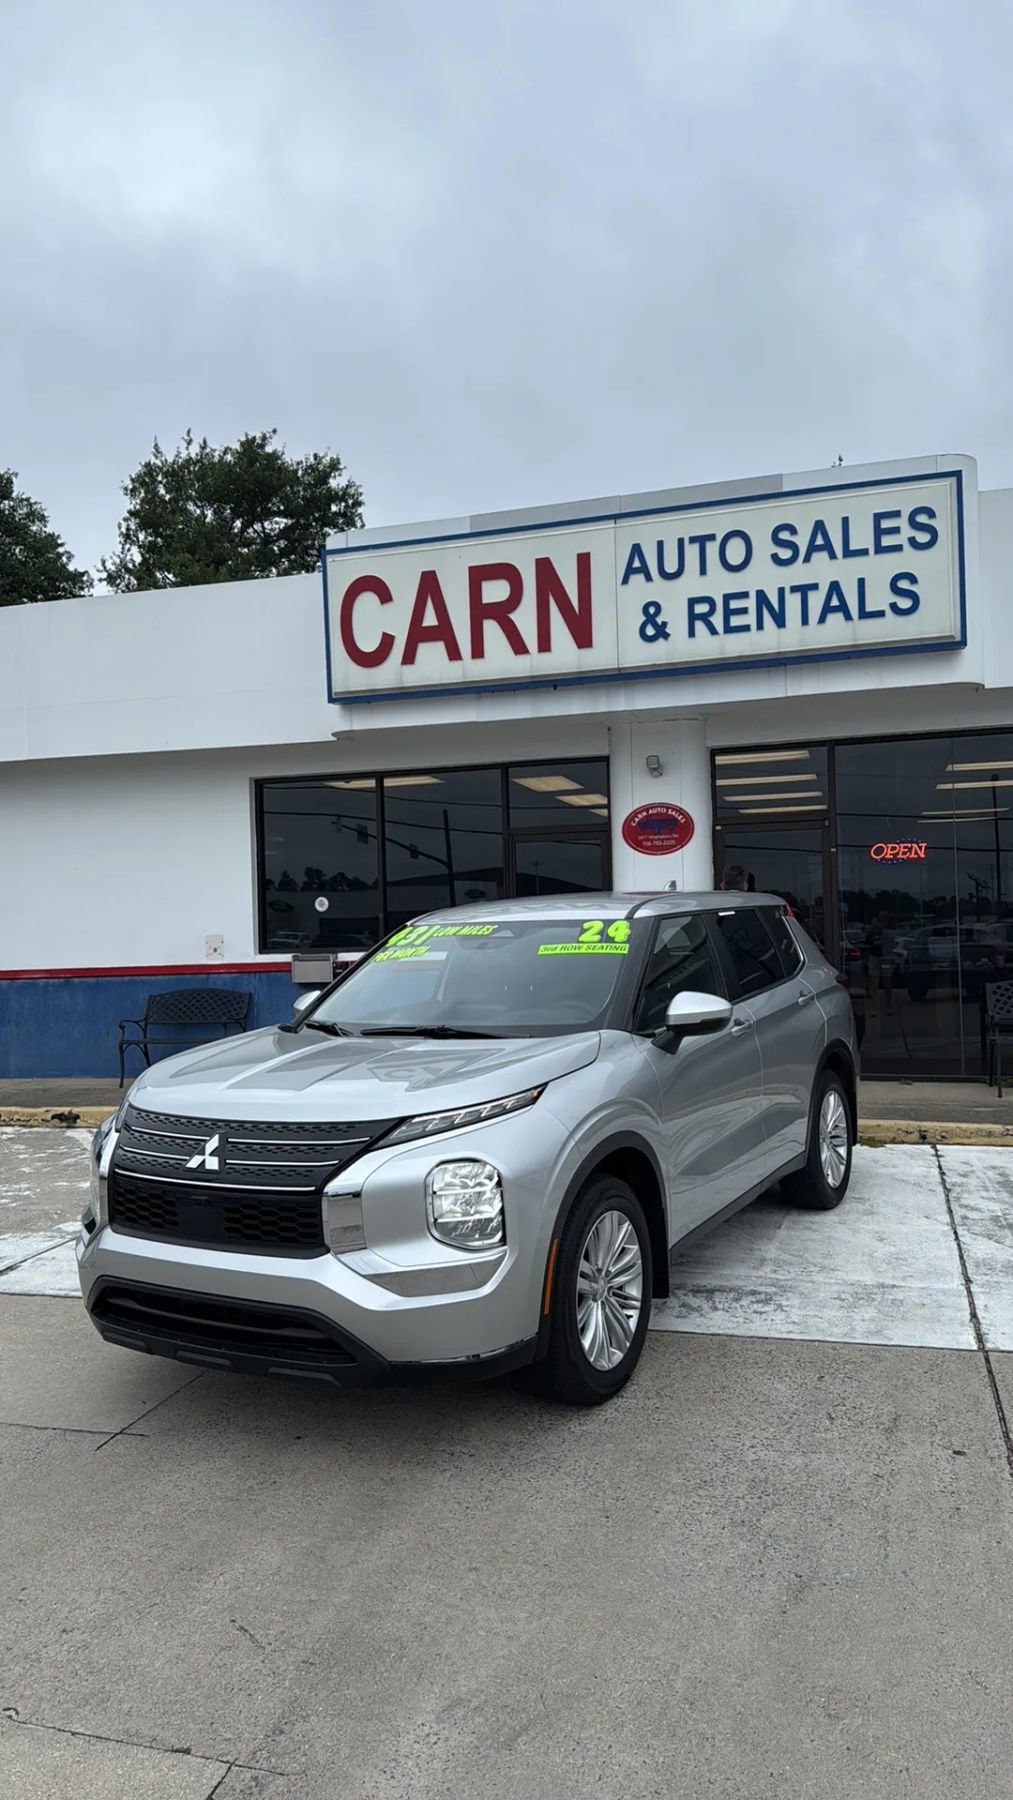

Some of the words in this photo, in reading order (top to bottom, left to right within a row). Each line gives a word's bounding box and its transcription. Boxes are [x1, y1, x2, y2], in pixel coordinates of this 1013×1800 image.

[621, 529, 753, 585] AUTO
[770, 505, 939, 567] SALES
[341, 553, 594, 669] CARN
[639, 601, 670, 643] &
[686, 570, 921, 638] RENTALS
[870, 842, 928, 860] OPEN
[432, 926, 463, 937] LOW
[456, 925, 498, 936] MILES
[578, 919, 631, 943] 24
[560, 944, 583, 952] ROW
[585, 943, 627, 952] SEATING
